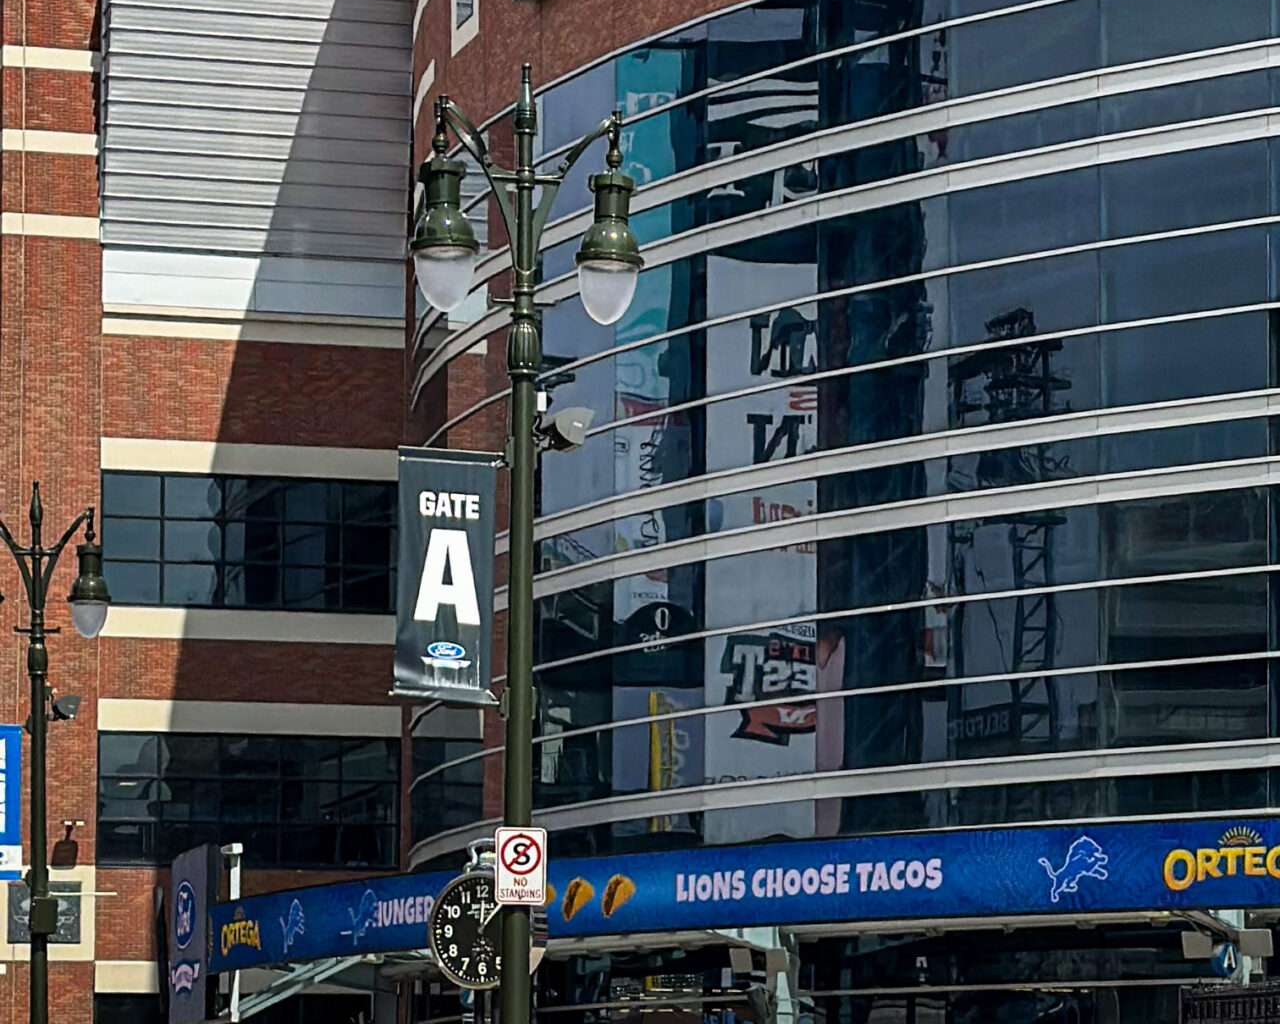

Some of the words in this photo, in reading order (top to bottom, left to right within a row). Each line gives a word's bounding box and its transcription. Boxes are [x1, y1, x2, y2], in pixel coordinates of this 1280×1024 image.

[419, 490, 480, 520] GATE
[413, 527, 481, 626] A
[513, 877, 528, 888] NO
[676, 868, 746, 902] LIONS
[752, 862, 850, 899] CHOOSE
[856, 857, 943, 892] TACOS
[461, 891, 471, 904] 11
[476, 885, 489, 898] 12
[499, 888, 542, 900] STANDING
[446, 905, 461, 919] 10
[220, 919, 261, 957] ORTEGA
[444, 925, 453, 938] 9
[448, 944, 458, 957] 8
[461, 957, 470, 971] 7
[478, 962, 487, 975] 6
